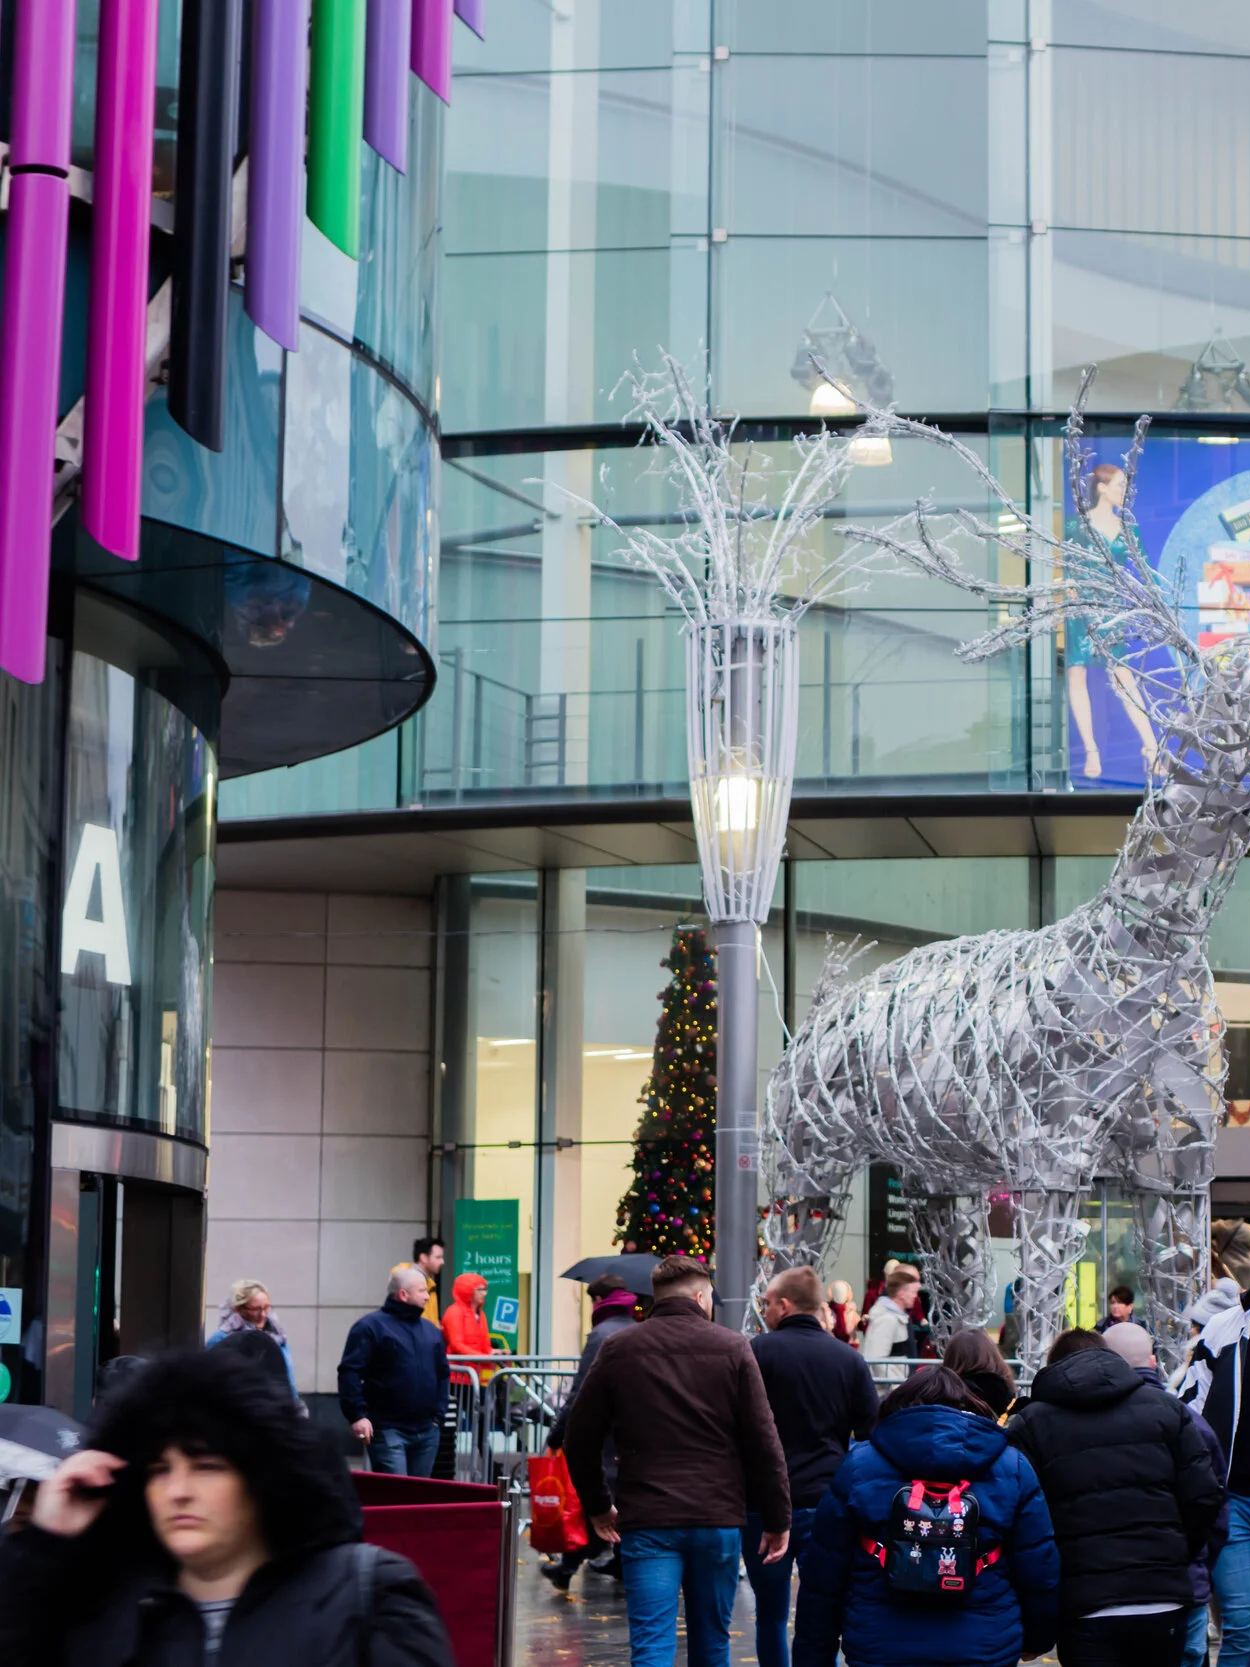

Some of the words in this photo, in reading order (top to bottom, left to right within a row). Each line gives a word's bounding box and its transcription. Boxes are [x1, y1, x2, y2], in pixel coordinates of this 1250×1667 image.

[61, 822, 131, 986] A
[463, 1250, 472, 1265] 2
[475, 1250, 512, 1265] hours
[501, 1302, 514, 1320] P
